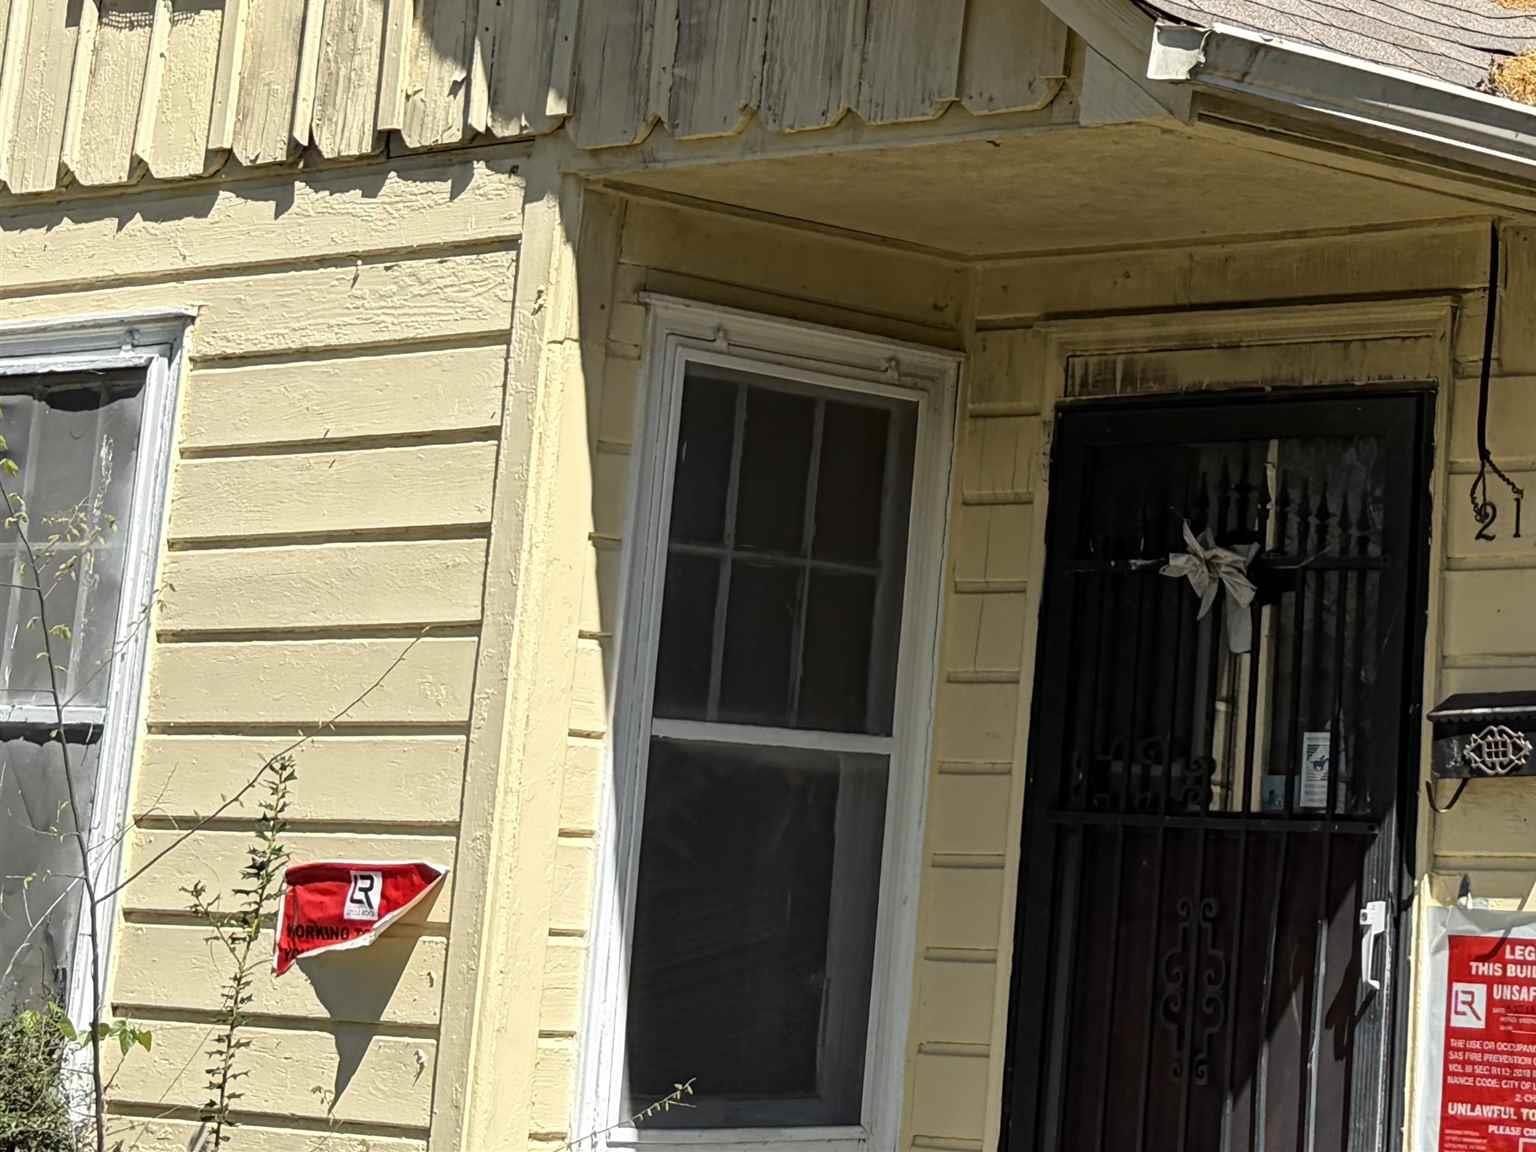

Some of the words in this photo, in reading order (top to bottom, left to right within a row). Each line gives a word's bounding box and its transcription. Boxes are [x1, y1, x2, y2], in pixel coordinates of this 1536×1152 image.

[1469, 961, 1503, 976] THIS
[1466, 1040, 1482, 1049] USE
[1465, 1052, 1482, 1061] FIRE
[1483, 1053, 1532, 1065] PREVENTION
[1501, 1078, 1519, 1089] CITY
[1520, 1080, 1531, 1090] OF
[1448, 1101, 1518, 1119] UNLAWFUL
[1488, 1124, 1521, 1136] PLEASE
